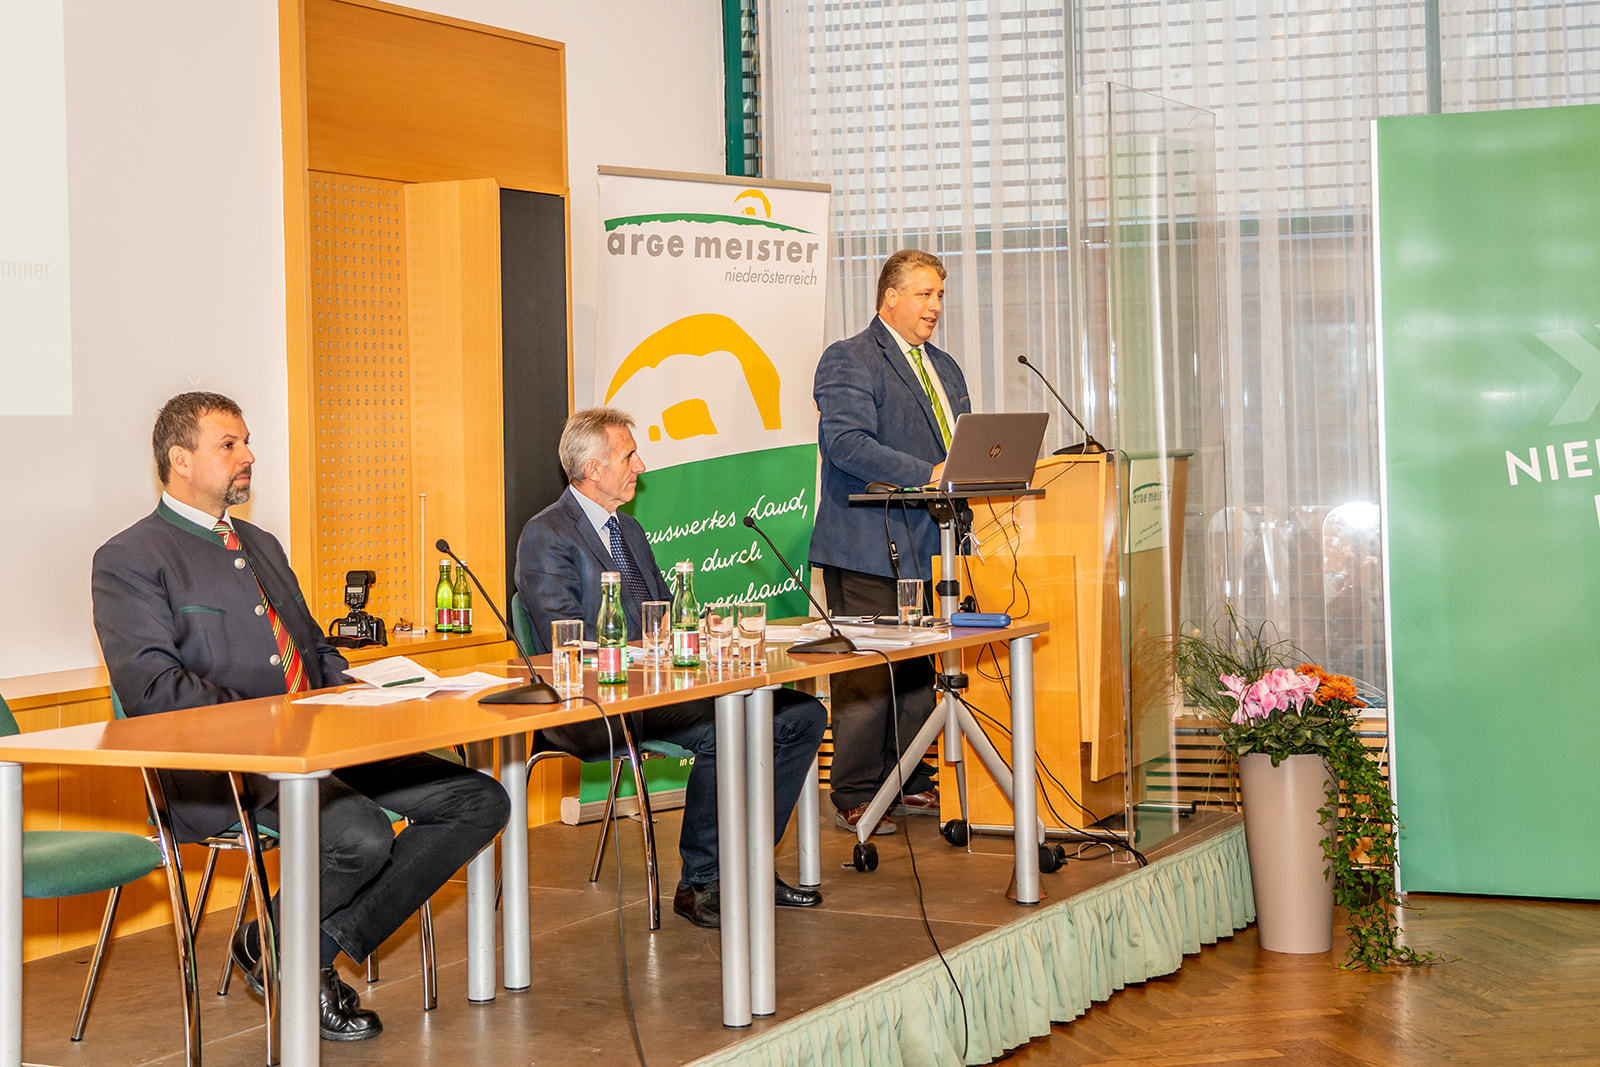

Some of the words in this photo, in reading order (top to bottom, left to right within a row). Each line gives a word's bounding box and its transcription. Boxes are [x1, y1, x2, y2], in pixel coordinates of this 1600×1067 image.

[725, 266, 817, 285] niederösterreich
[1505, 438, 1600, 486] NIE
[701, 541, 763, 573] durch
